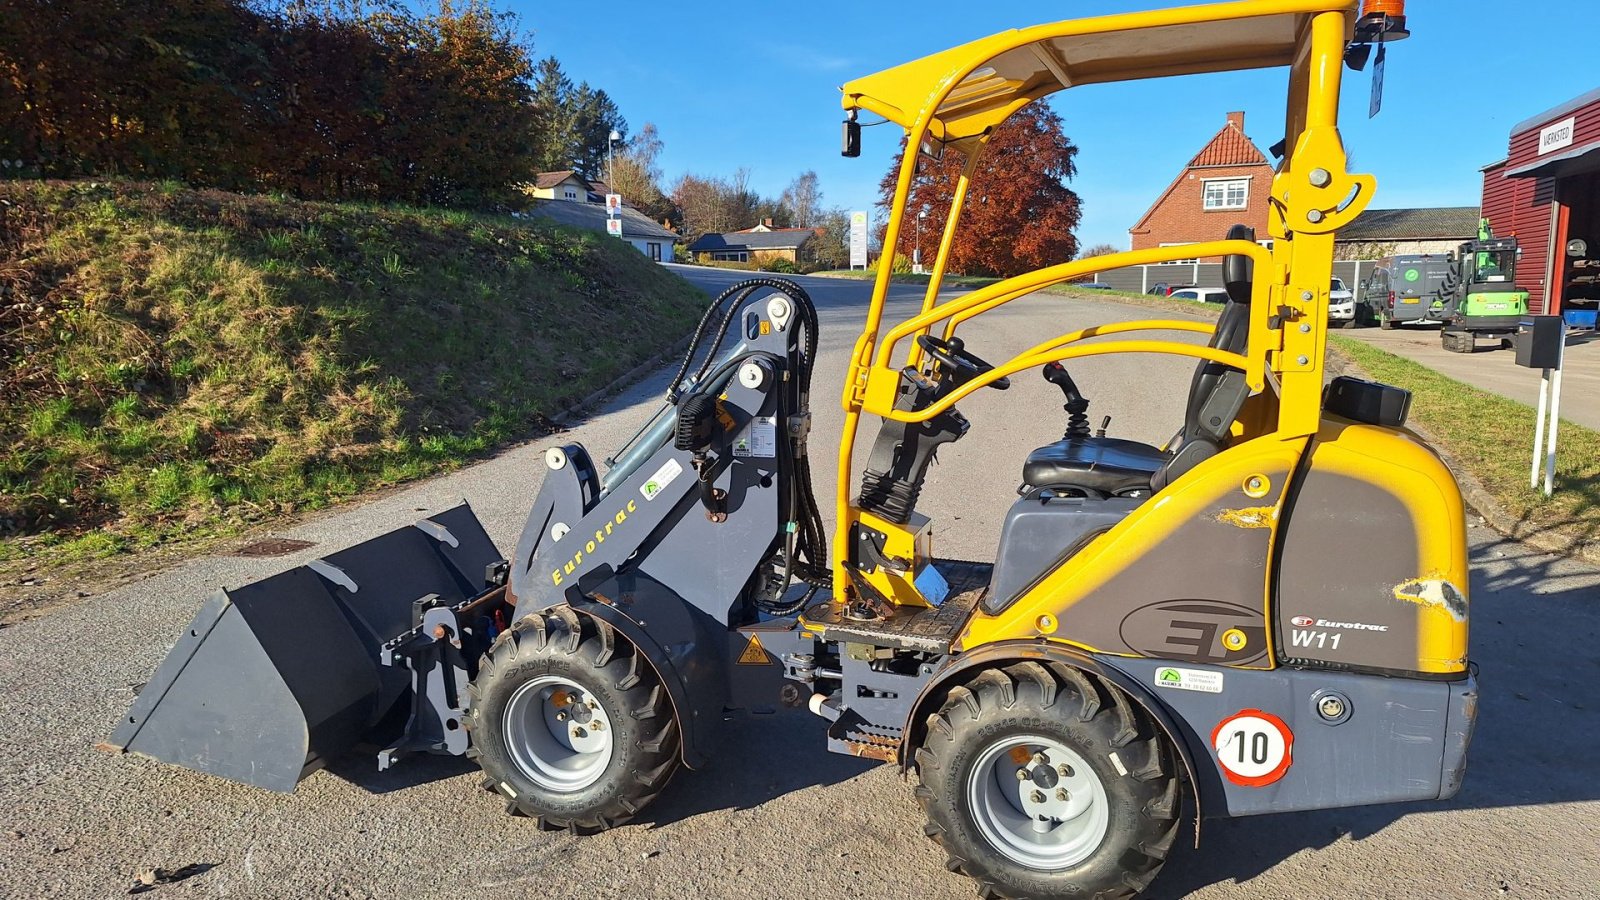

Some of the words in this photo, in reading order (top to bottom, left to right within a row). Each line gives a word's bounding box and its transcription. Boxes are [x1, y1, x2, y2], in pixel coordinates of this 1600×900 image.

[551, 499, 638, 586] Eurotrac
[1291, 629, 1342, 650] W11
[1315, 619, 1389, 632] Eurotrac
[1233, 730, 1269, 765] 10
